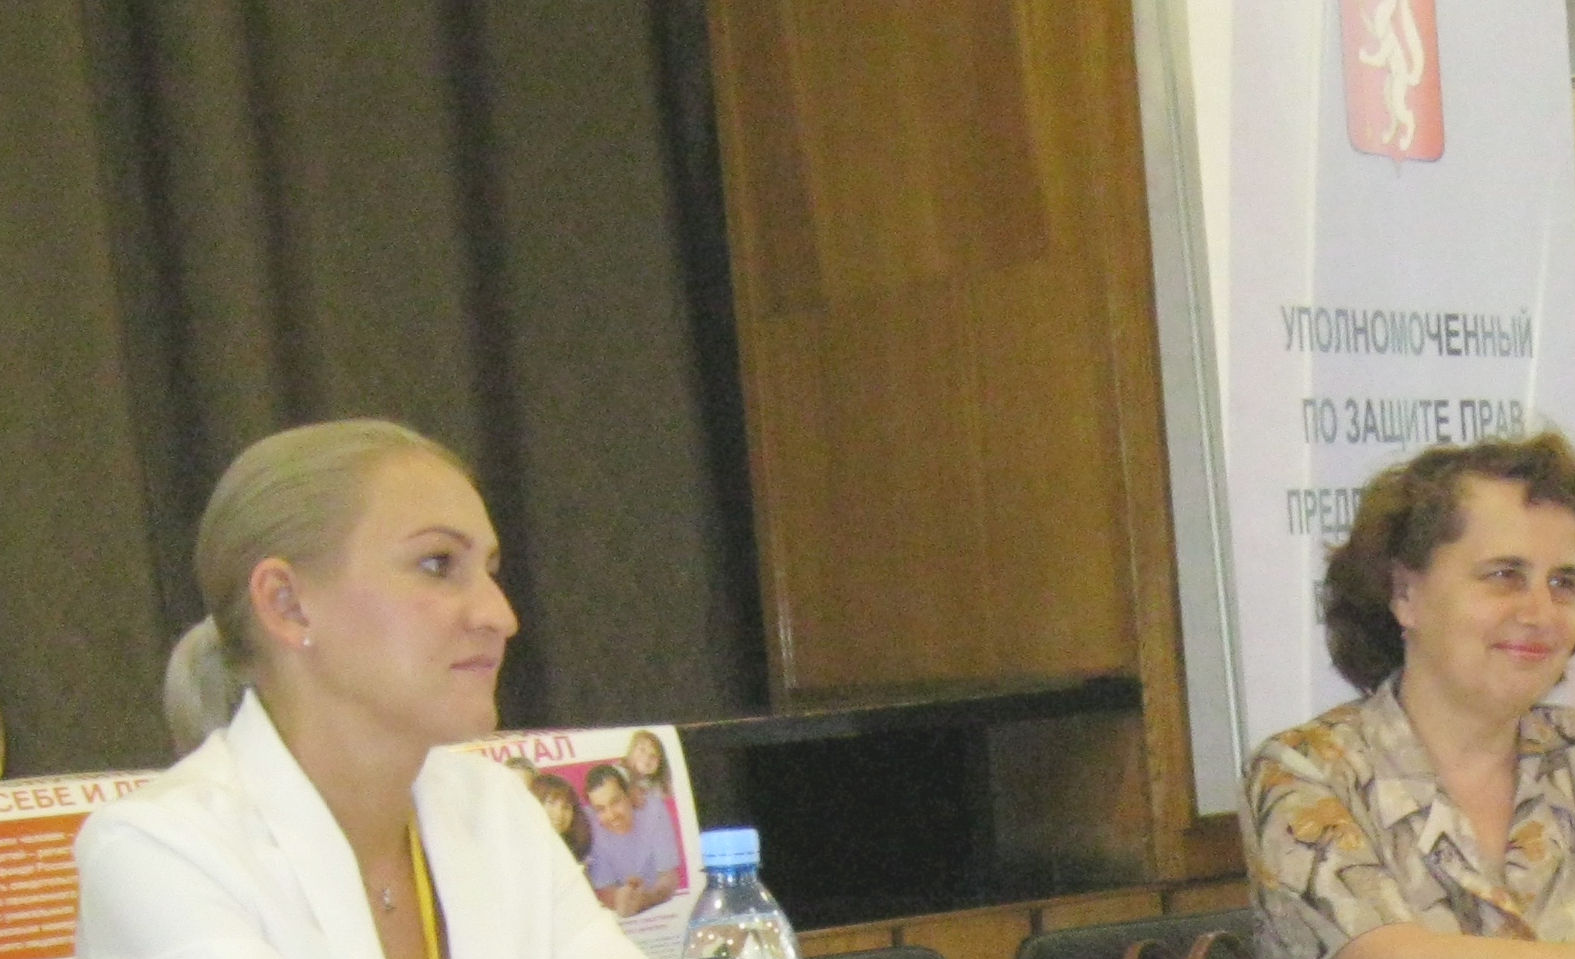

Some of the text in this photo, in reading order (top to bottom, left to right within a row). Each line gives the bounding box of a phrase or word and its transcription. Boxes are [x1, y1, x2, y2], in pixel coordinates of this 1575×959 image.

[1281, 305, 1534, 358] УПОЛНОМОЧЕННЫЙ
[1303, 398, 1526, 450] ПО ЗАЩИТЕ ПРАВ
[480, 735, 576, 764] ИТАЛ
[81, 783, 106, 803] И
